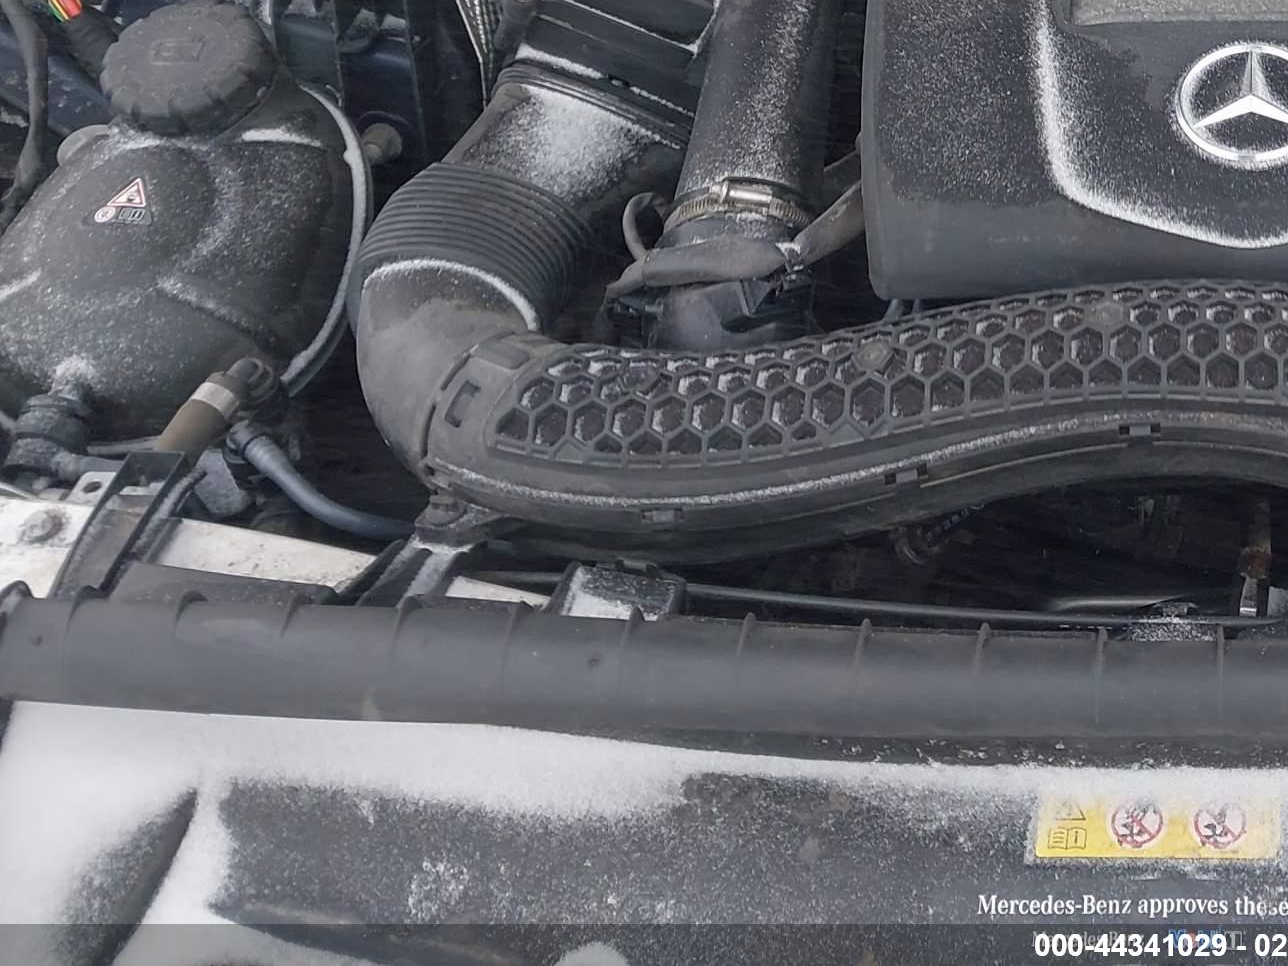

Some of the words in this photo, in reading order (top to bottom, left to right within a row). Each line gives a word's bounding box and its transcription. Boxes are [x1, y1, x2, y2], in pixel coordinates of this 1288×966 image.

[978, 895, 1131, 915] Mercedes-Benz
[1138, 898, 1229, 918] approves
[1236, 896, 1288, 916] these
